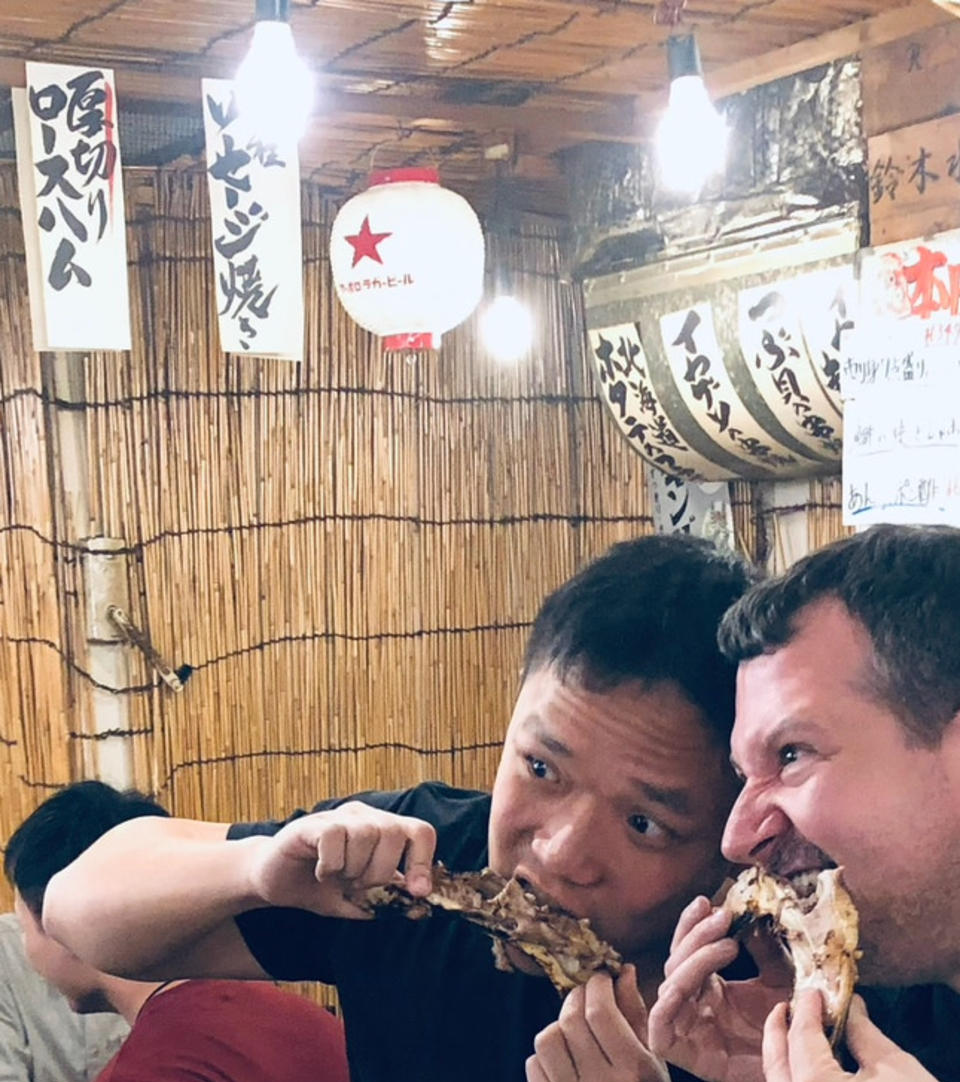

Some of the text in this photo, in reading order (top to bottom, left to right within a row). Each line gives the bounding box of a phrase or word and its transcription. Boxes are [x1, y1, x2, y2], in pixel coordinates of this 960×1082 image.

[29, 83, 92, 291] ロースハム
[66, 70, 117, 243] 厚切り
